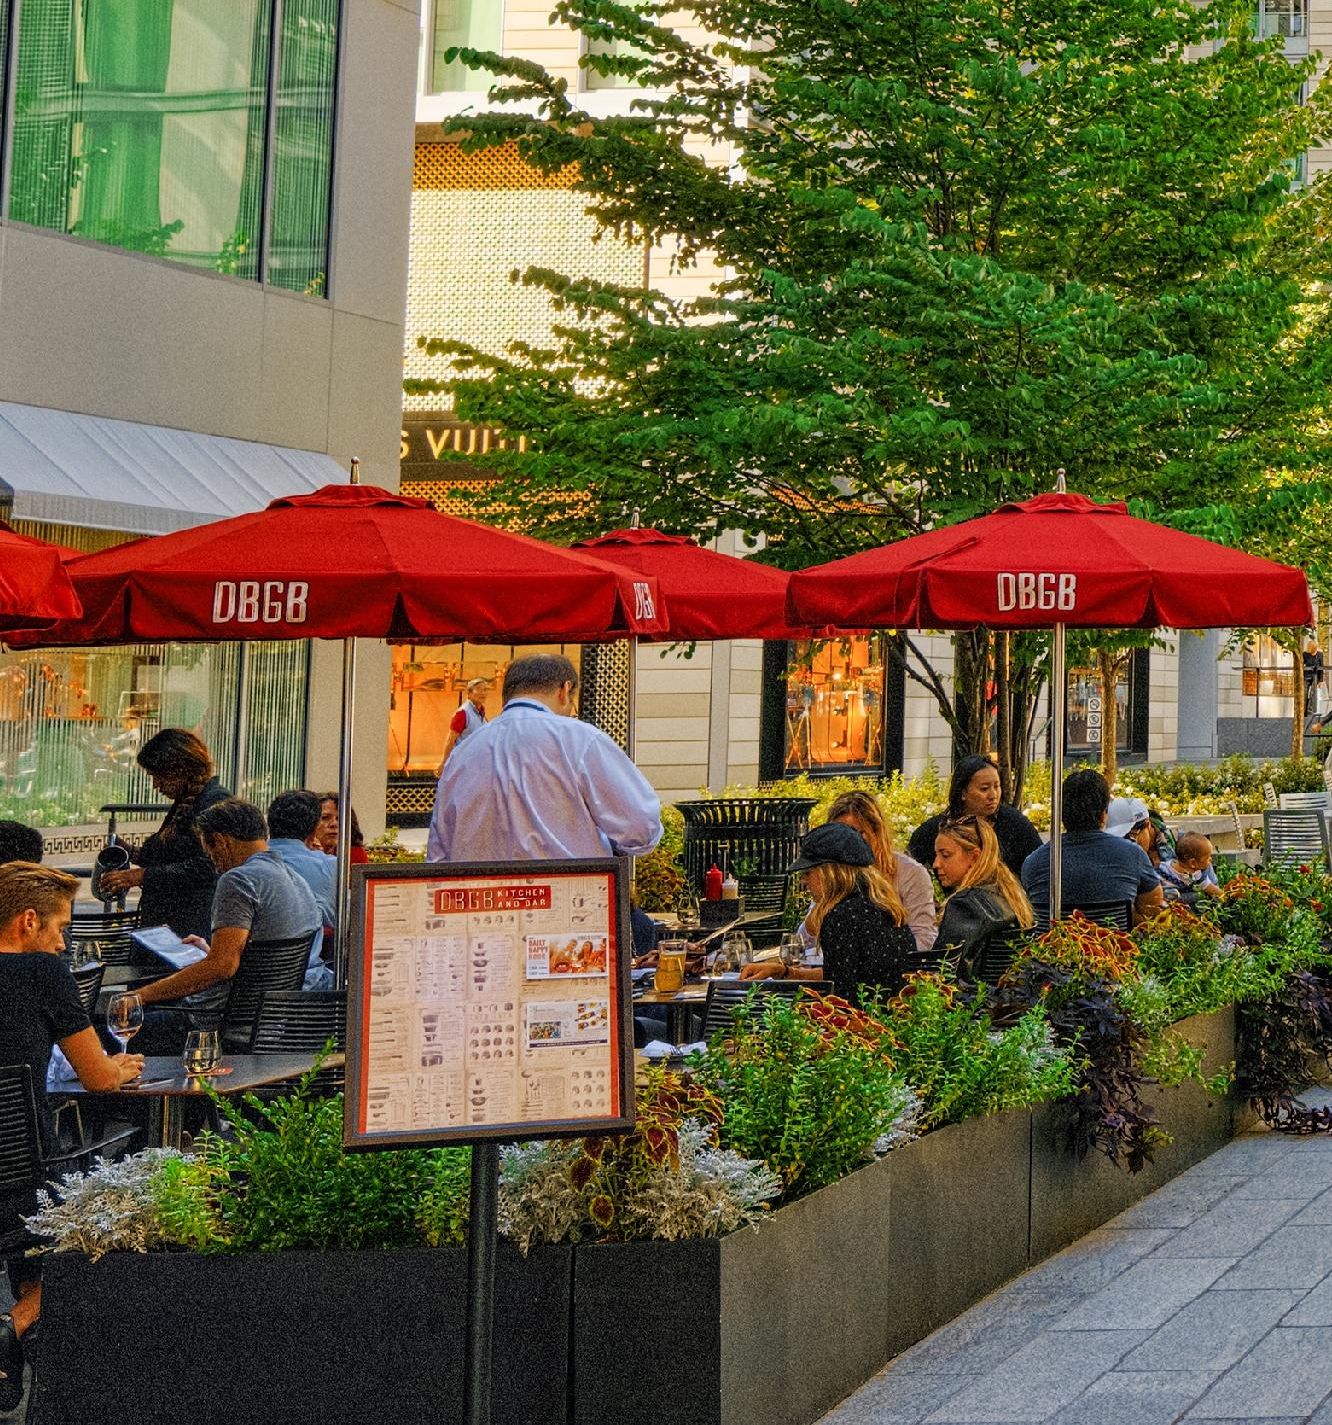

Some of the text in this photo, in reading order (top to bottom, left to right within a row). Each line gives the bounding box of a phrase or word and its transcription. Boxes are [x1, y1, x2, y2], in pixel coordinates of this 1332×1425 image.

[212, 581, 309, 623] DBGB
[997, 572, 1076, 611] DBGB
[440, 890, 493, 911] DBGB
[497, 888, 545, 898] KITCHEN
[498, 900, 520, 909] AND
